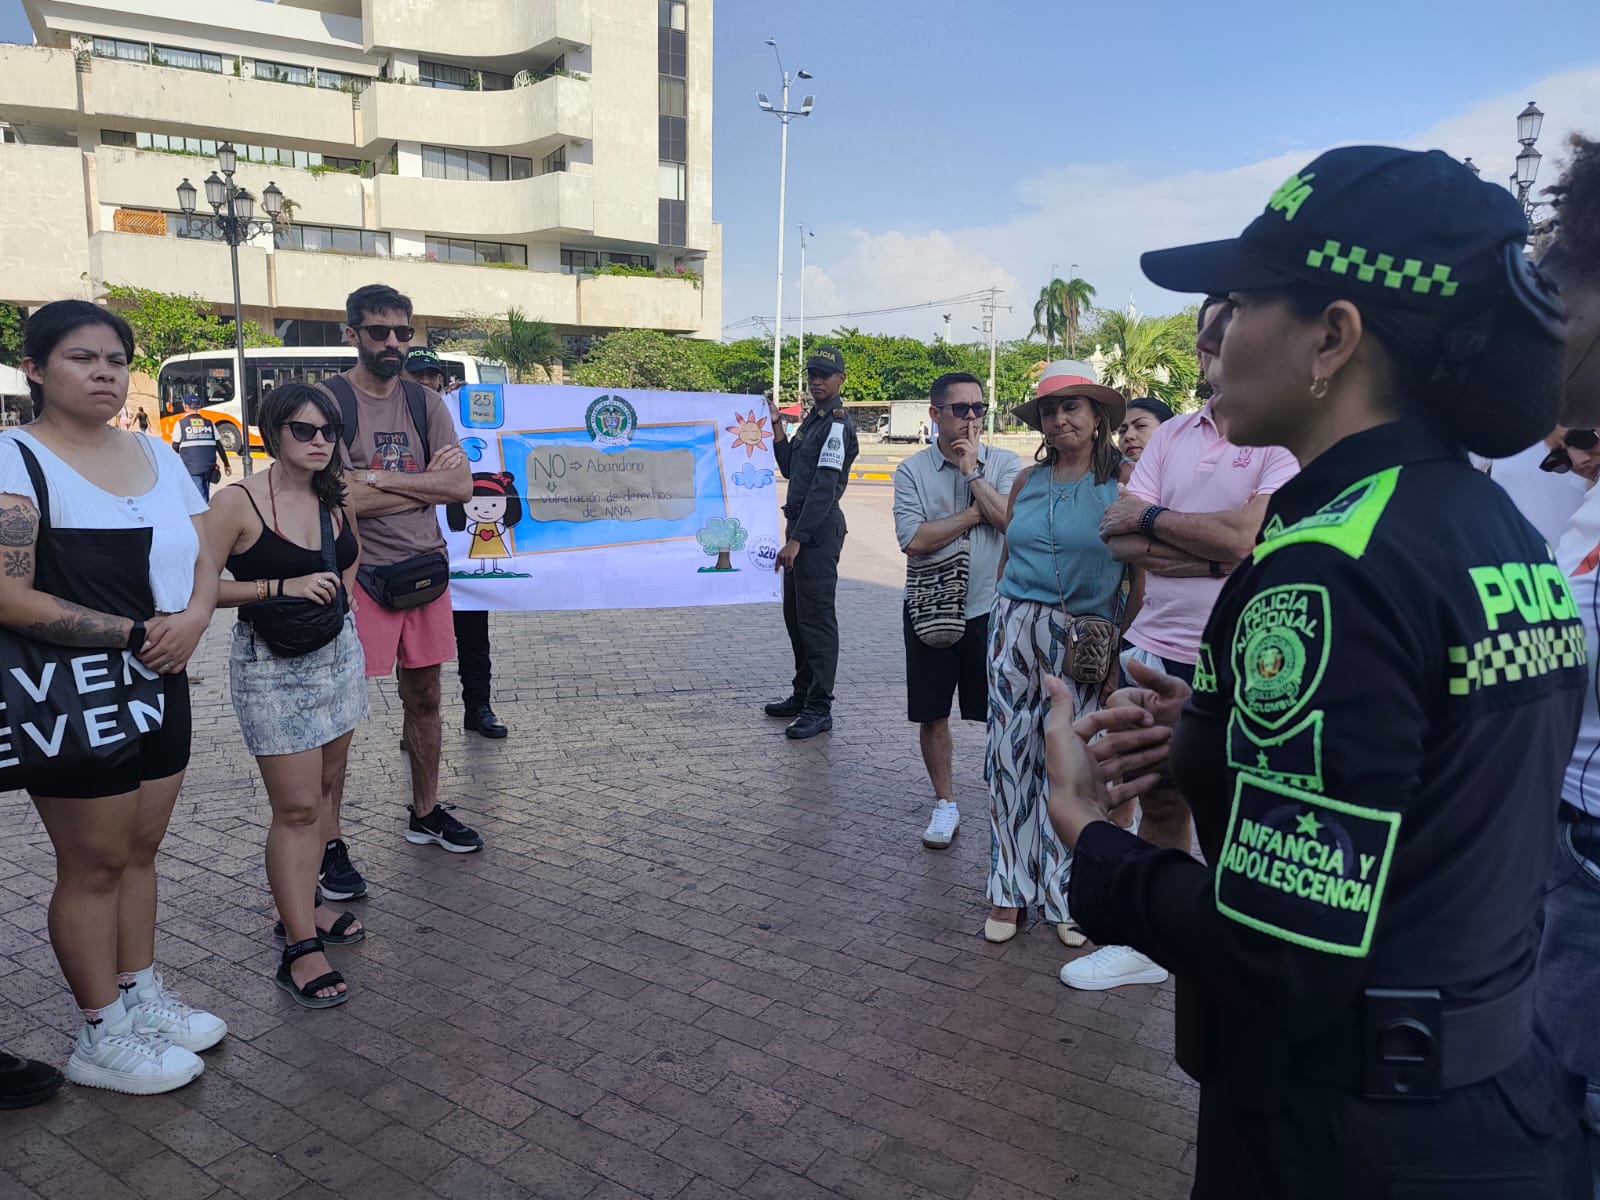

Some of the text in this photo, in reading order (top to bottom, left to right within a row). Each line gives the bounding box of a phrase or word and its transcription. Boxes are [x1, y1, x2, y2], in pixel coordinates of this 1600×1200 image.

[473, 394, 491, 407] 25
[533, 454, 645, 480] NO Abandono
[606, 490, 618, 503] de
[623, 488, 673, 501] derechos
[582, 505, 632, 518] de NNA
[1237, 611, 1317, 654] NACIONAL
[1238, 818, 1376, 880] INFANCIA Y
[1224, 843, 1372, 913] ADOLESCENCIA
